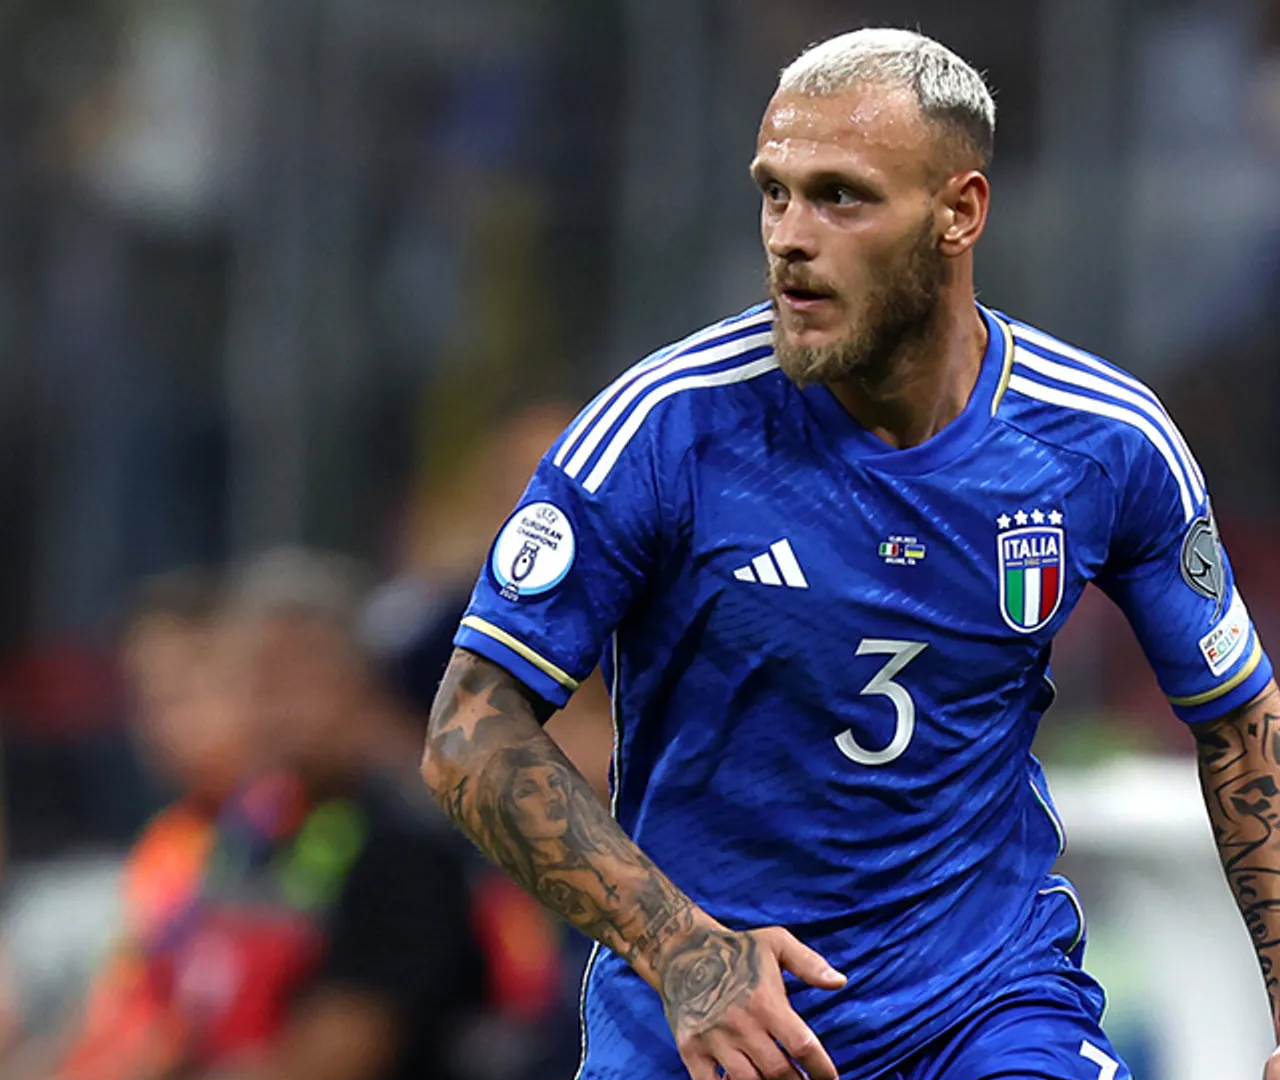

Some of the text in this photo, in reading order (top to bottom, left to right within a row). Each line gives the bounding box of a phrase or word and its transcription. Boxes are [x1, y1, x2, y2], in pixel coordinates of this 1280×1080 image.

[516, 526, 558, 551] CHAMPIONS
[521, 517, 563, 541] EUROPEAN
[1004, 536, 1059, 560] ITALIA
[833, 637, 929, 766] 3
